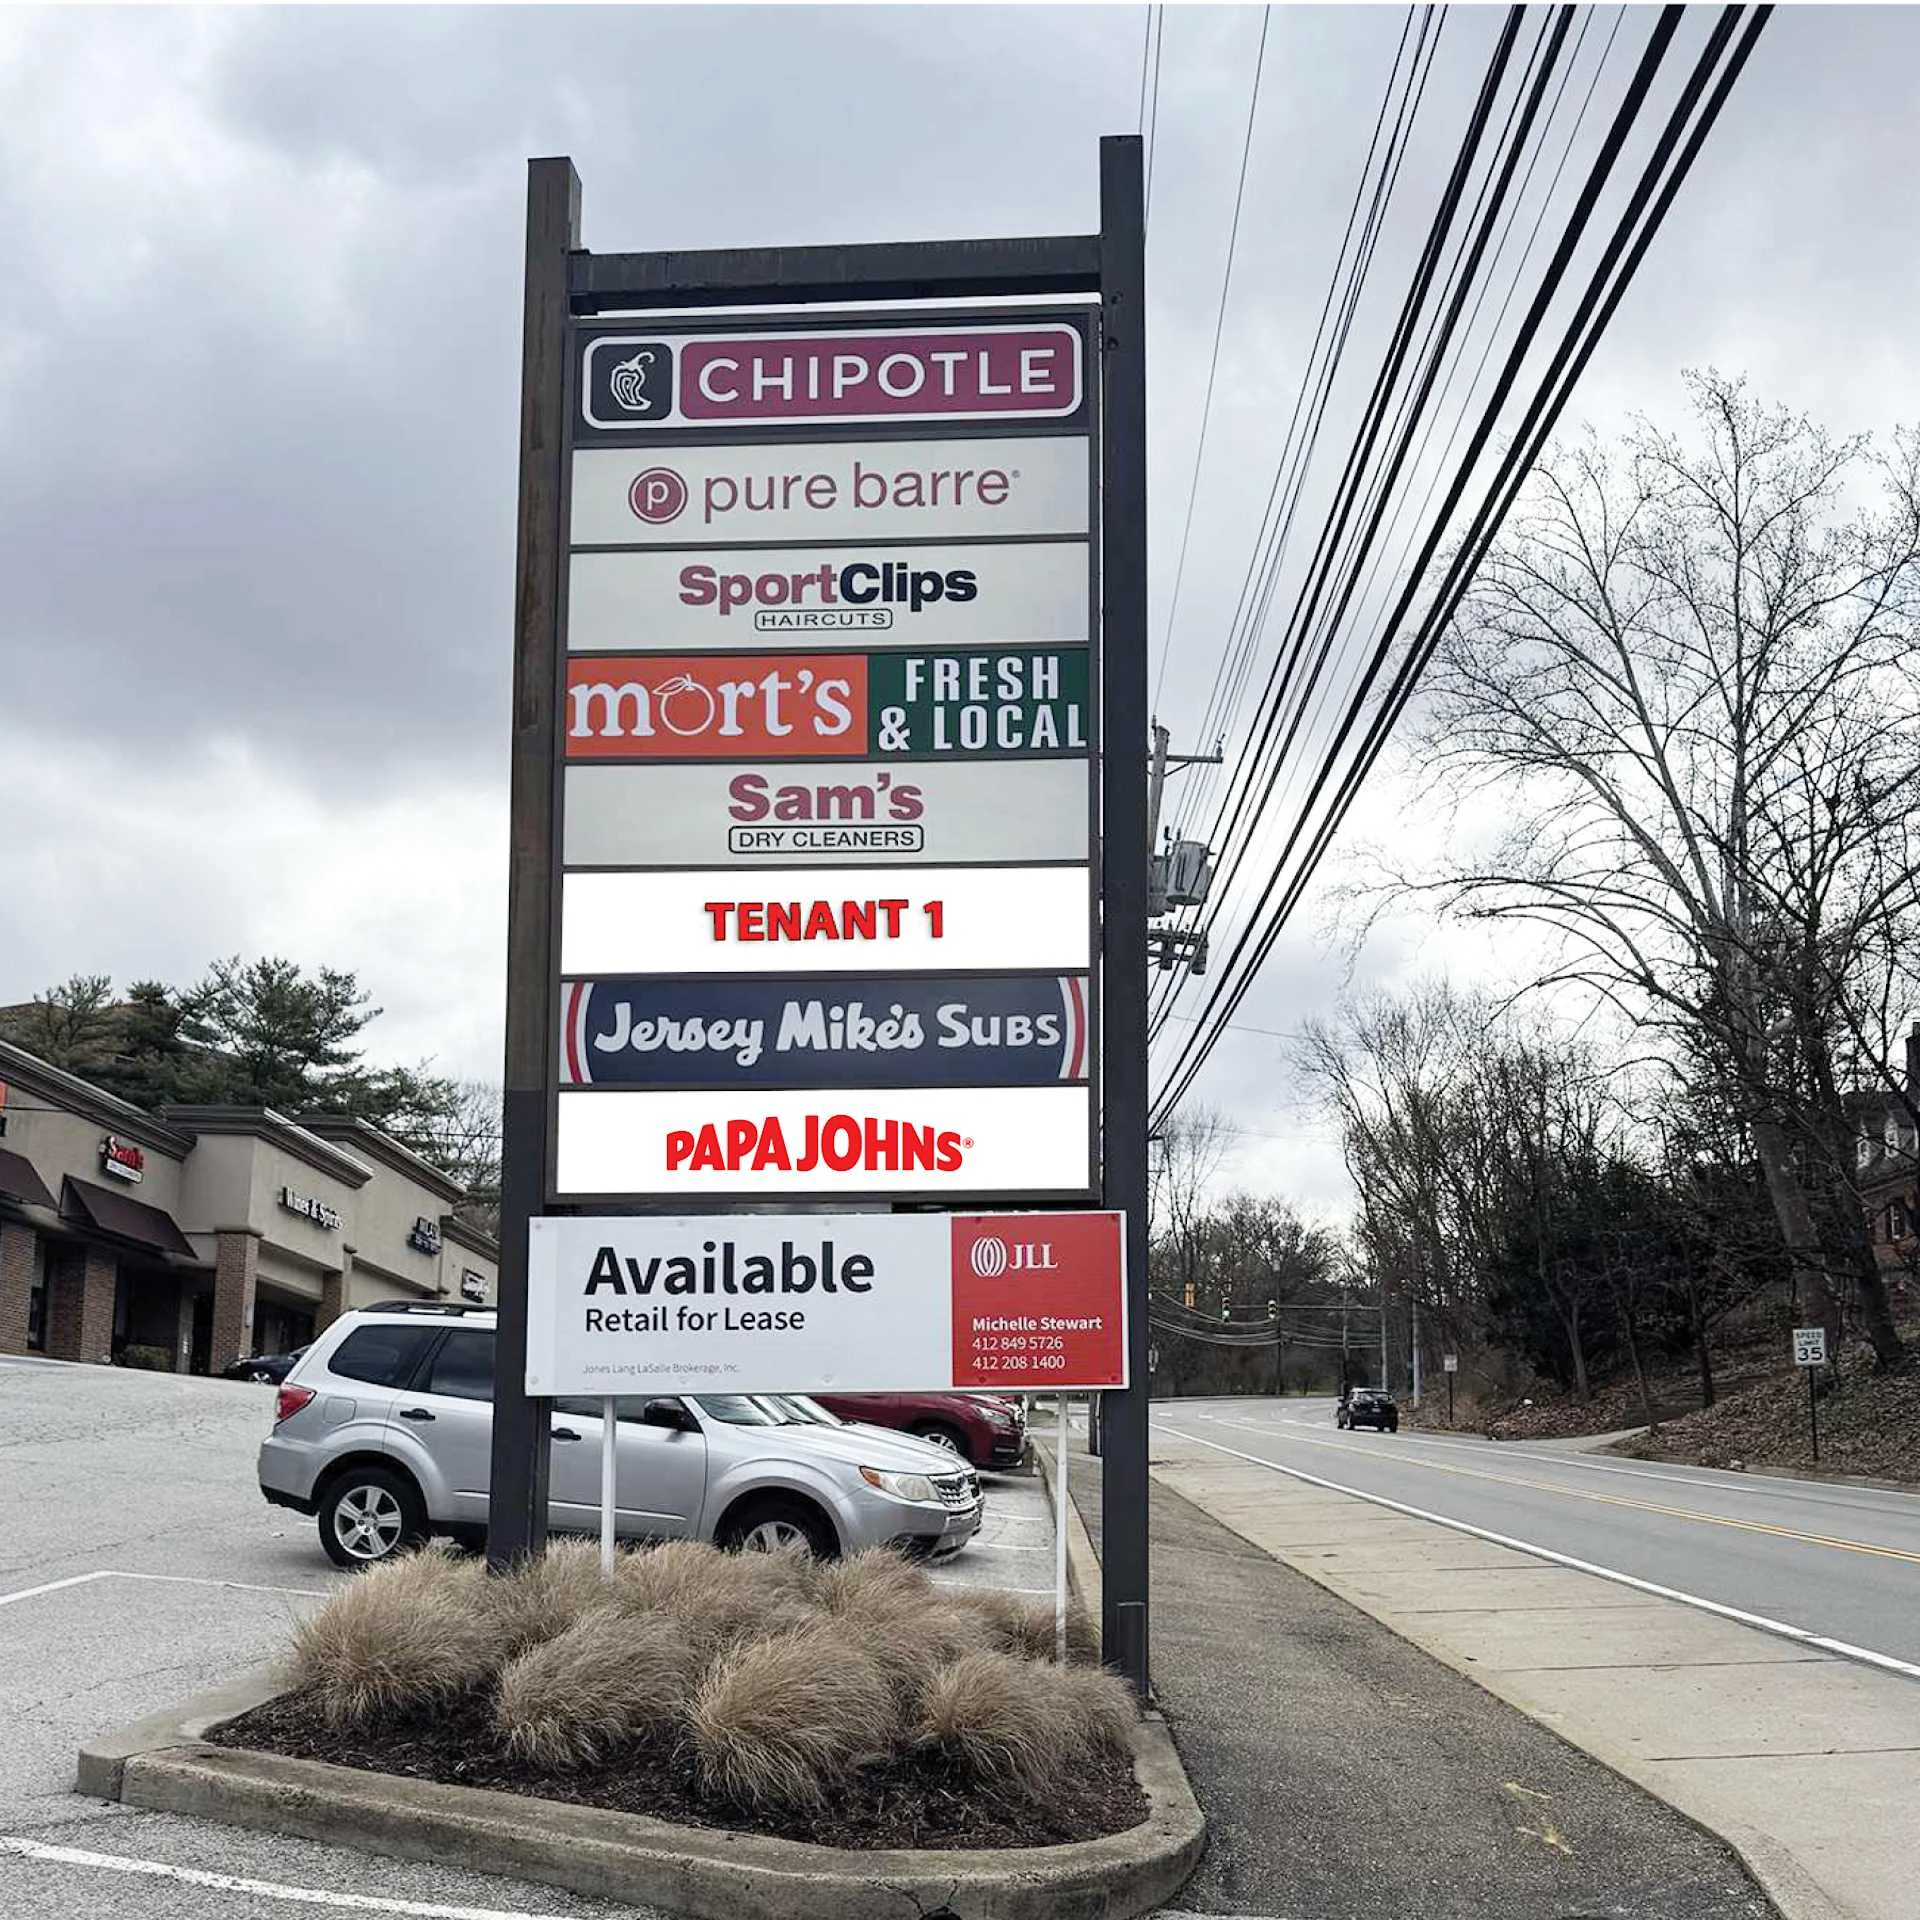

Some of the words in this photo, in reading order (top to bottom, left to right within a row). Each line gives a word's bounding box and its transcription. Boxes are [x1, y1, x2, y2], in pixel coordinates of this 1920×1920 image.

[699, 348, 1056, 402] CHIPOTLE
[704, 473, 838, 524] pure
[854, 462, 1010, 508] barre
[679, 562, 978, 615] SportClips
[761, 611, 886, 628] HAIRCUTS
[905, 656, 1058, 702] FRESH
[569, 670, 852, 737] mort's
[878, 706, 911, 751] &
[933, 704, 1087, 749] LOCAL
[728, 772, 924, 822] Sam's
[739, 830, 785, 848] DRY
[793, 829, 915, 848] CLEANERS
[704, 899, 909, 942] TENANT
[922, 901, 944, 939] 1
[593, 1002, 764, 1067] Jersey
[775, 1000, 925, 1052] Mike's
[666, 1117, 792, 1171] PAPA
[584, 1241, 875, 1295] Available
[1008, 1243, 1059, 1270] JLL
[586, 1306, 669, 1332] Retail
[676, 1305, 718, 1331] for
[724, 1307, 806, 1331] Lease
[972, 1316, 1037, 1331] Michelle
[1040, 1316, 1103, 1330] Stewart
[972, 1337, 998, 1350] 412
[1000, 1337, 1026, 1350] 849
[1029, 1336, 1064, 1349] 5726
[972, 1357, 998, 1369] 412
[1001, 1356, 1028, 1369] 208
[1031, 1355, 1066, 1369] 1400
[1798, 1347, 1823, 1361] 35
[583, 1364, 610, 1374] Jones
[612, 1364, 635, 1375] Lang
[637, 1362, 671, 1374] LaSalle
